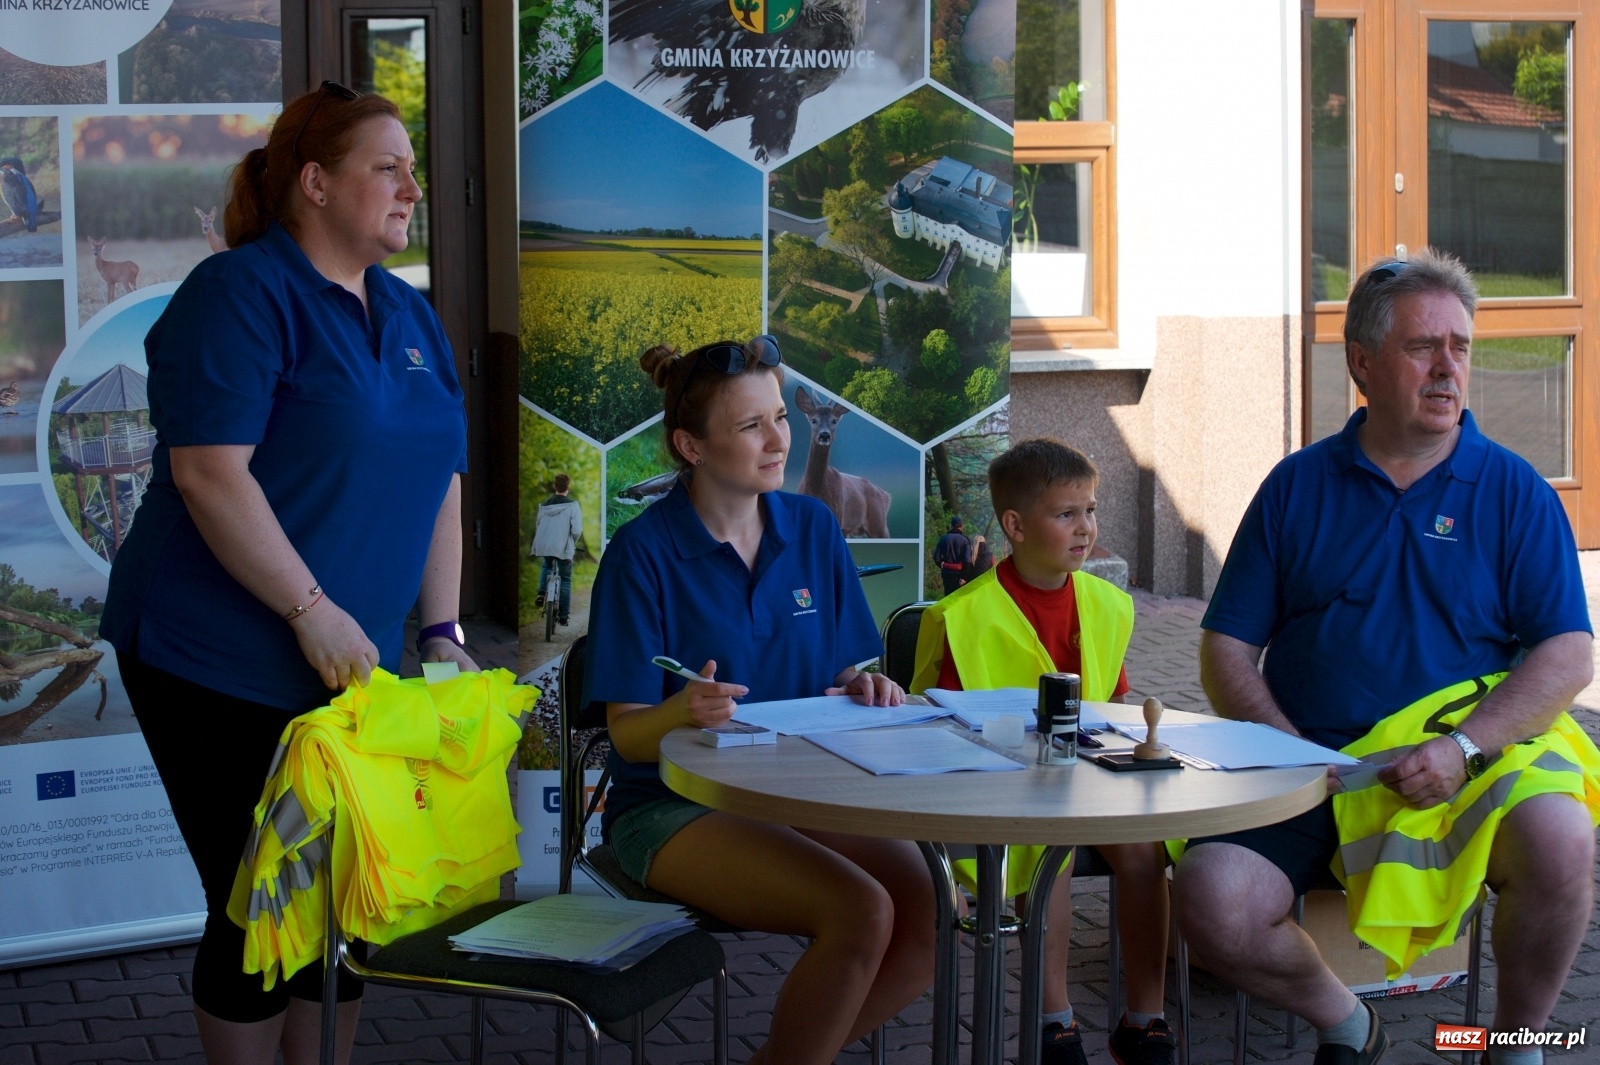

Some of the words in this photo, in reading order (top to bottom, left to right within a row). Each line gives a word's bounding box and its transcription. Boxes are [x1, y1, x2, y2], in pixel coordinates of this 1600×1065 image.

[661, 47, 724, 68] GMINA
[730, 43, 876, 69] KRZYŻANOWICE
[116, 766, 131, 775] UNIE
[116, 774, 133, 782] FOND
[81, 785, 119, 793] EUROPEJSKI
[121, 781, 151, 789] FUNDUSZ
[142, 810, 156, 819] dla
[17, 832, 84, 847] Europejskiego
[87, 828, 132, 839] Funduszu
[135, 822, 174, 833] Rozwoju
[107, 838, 143, 850] ramach
[20, 866, 28, 874] w
[31, 859, 81, 872] Programie
[84, 851, 133, 866] INTERREG
[135, 849, 153, 860] V-A
